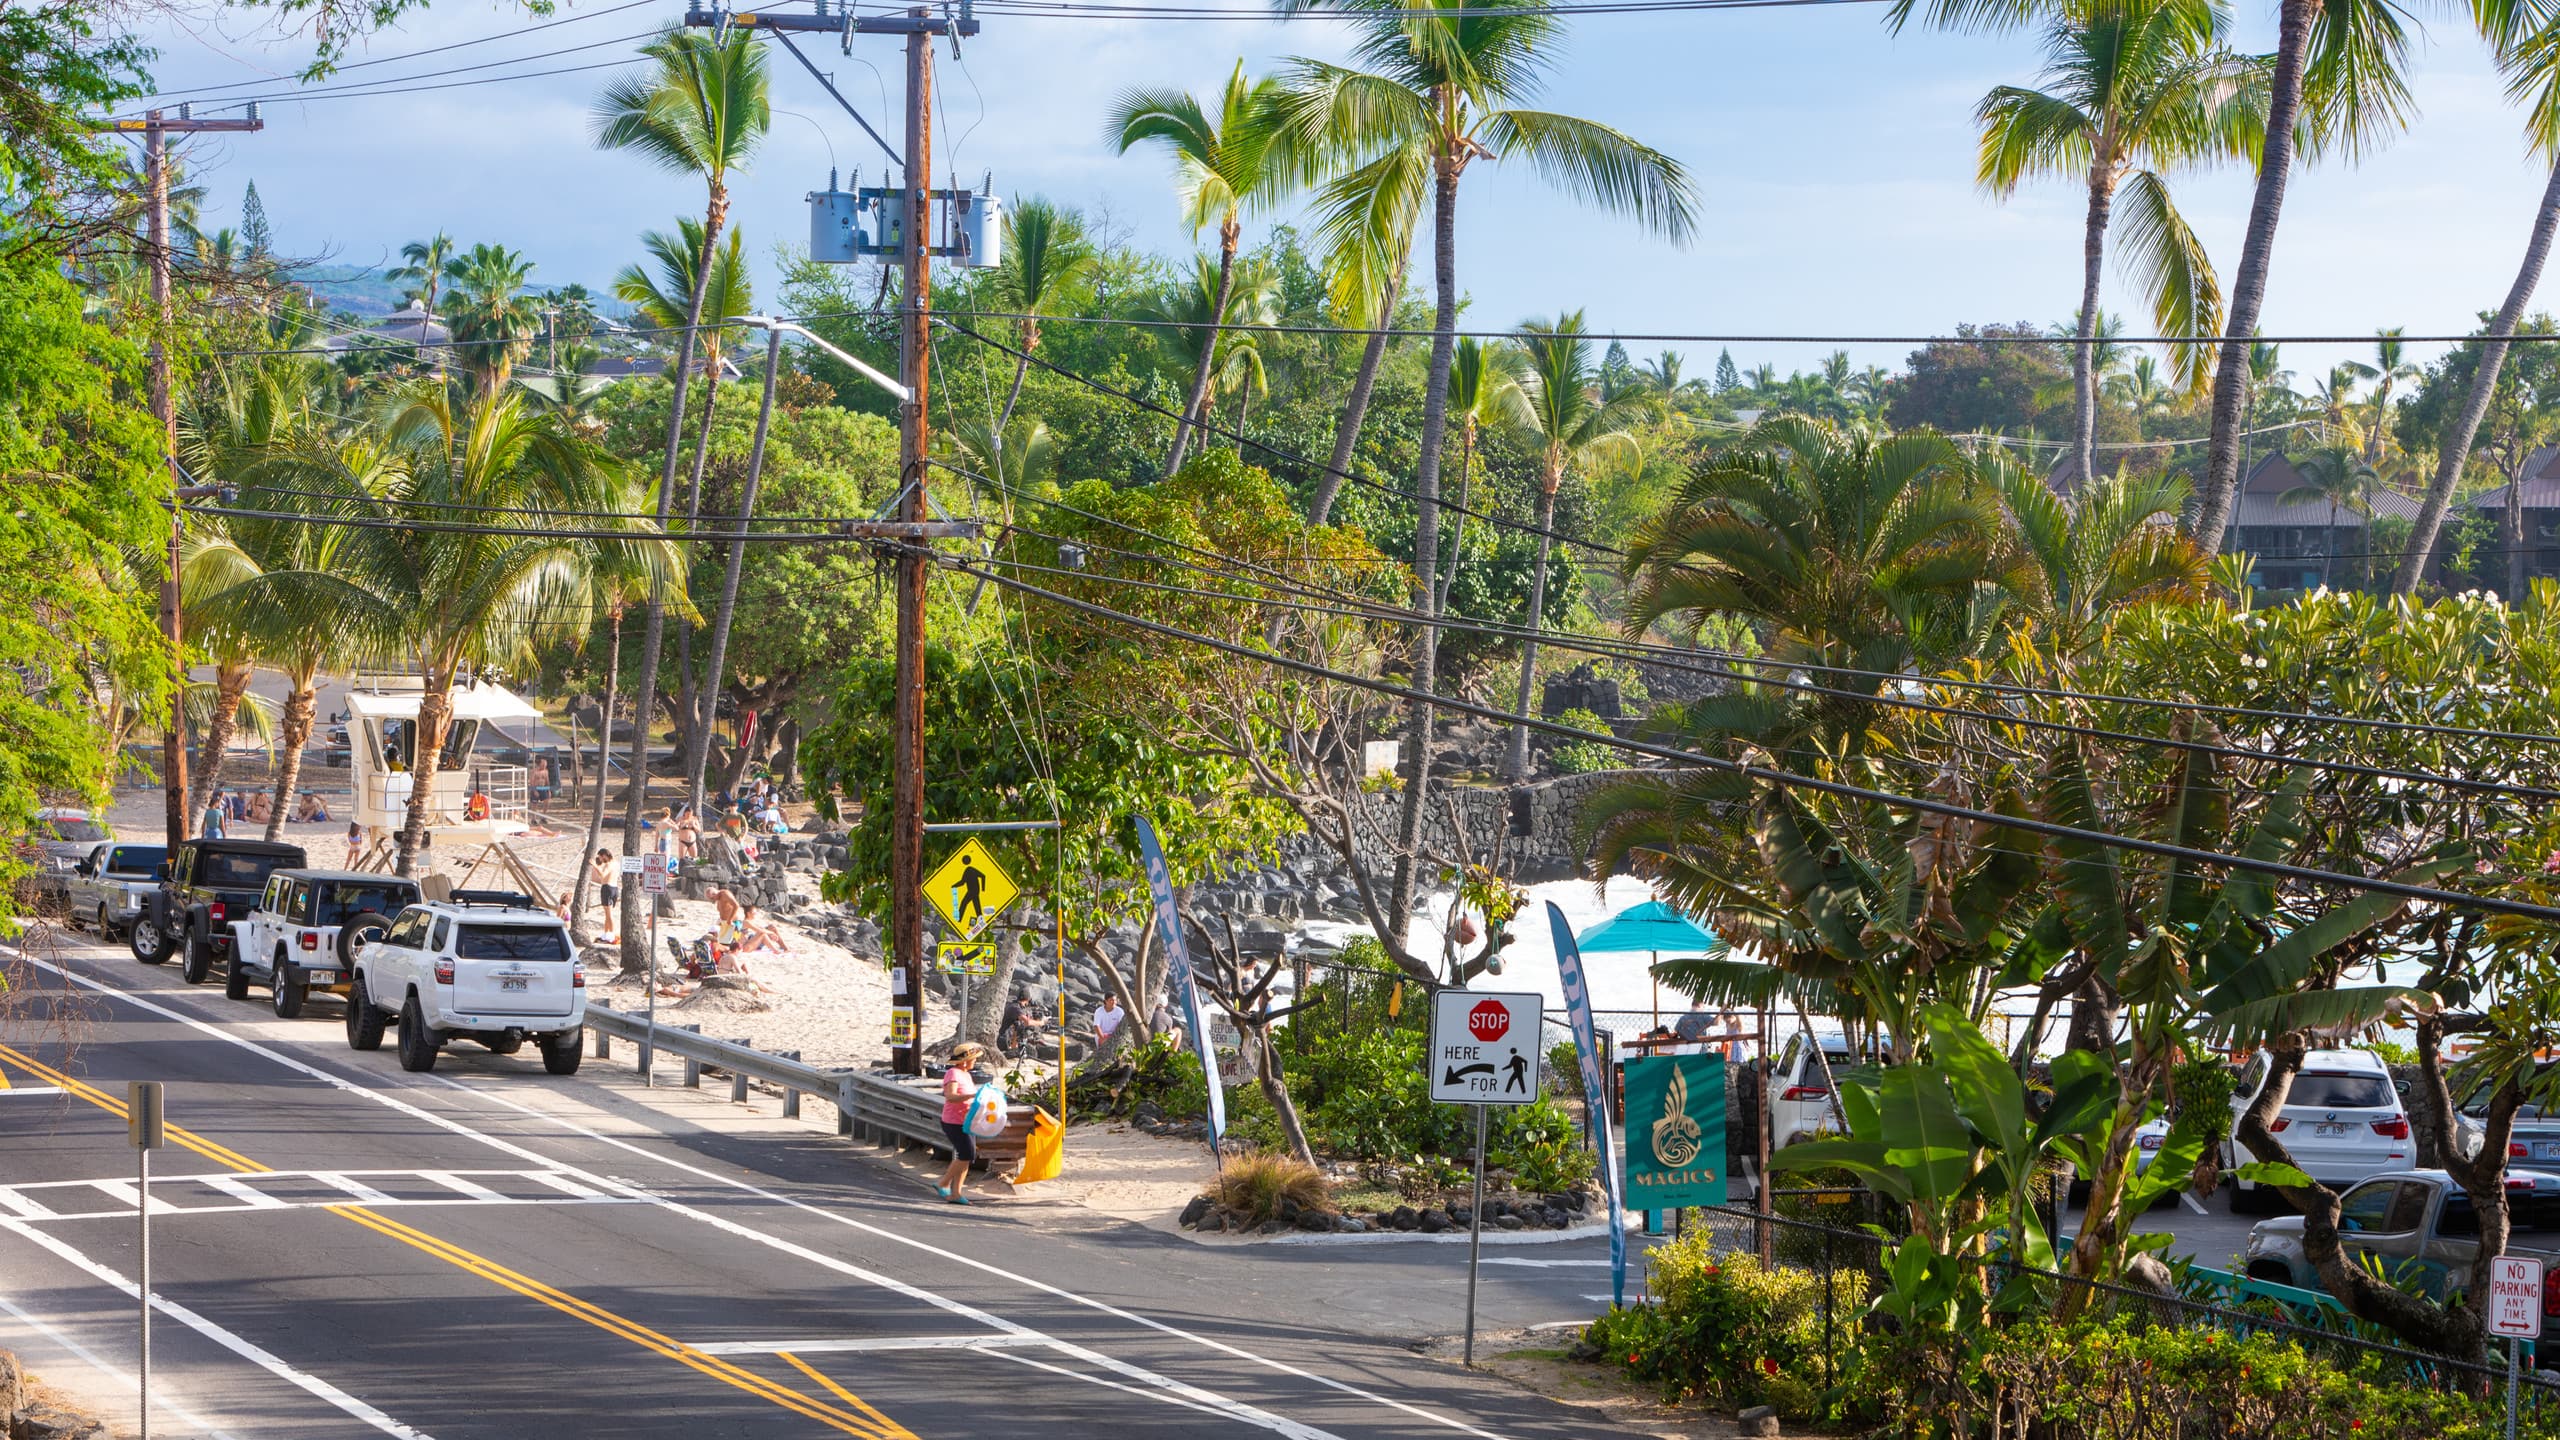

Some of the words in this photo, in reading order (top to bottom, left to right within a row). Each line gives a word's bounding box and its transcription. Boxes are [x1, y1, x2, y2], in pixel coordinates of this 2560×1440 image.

[650, 857, 660, 865] NO
[1470, 1012, 1508, 1030] STOP
[1445, 1046, 1480, 1060] HERE
[1221, 1063, 1237, 1076] LOVE
[1471, 1078, 1498, 1092] FOR
[1636, 1168, 1716, 1187] MAGICS
[2507, 1264, 2526, 1280] NO
[2495, 1281, 2537, 1298] PARKING
[2505, 1298, 2526, 1308] ANY
[2504, 1309, 2527, 1320] TIME
